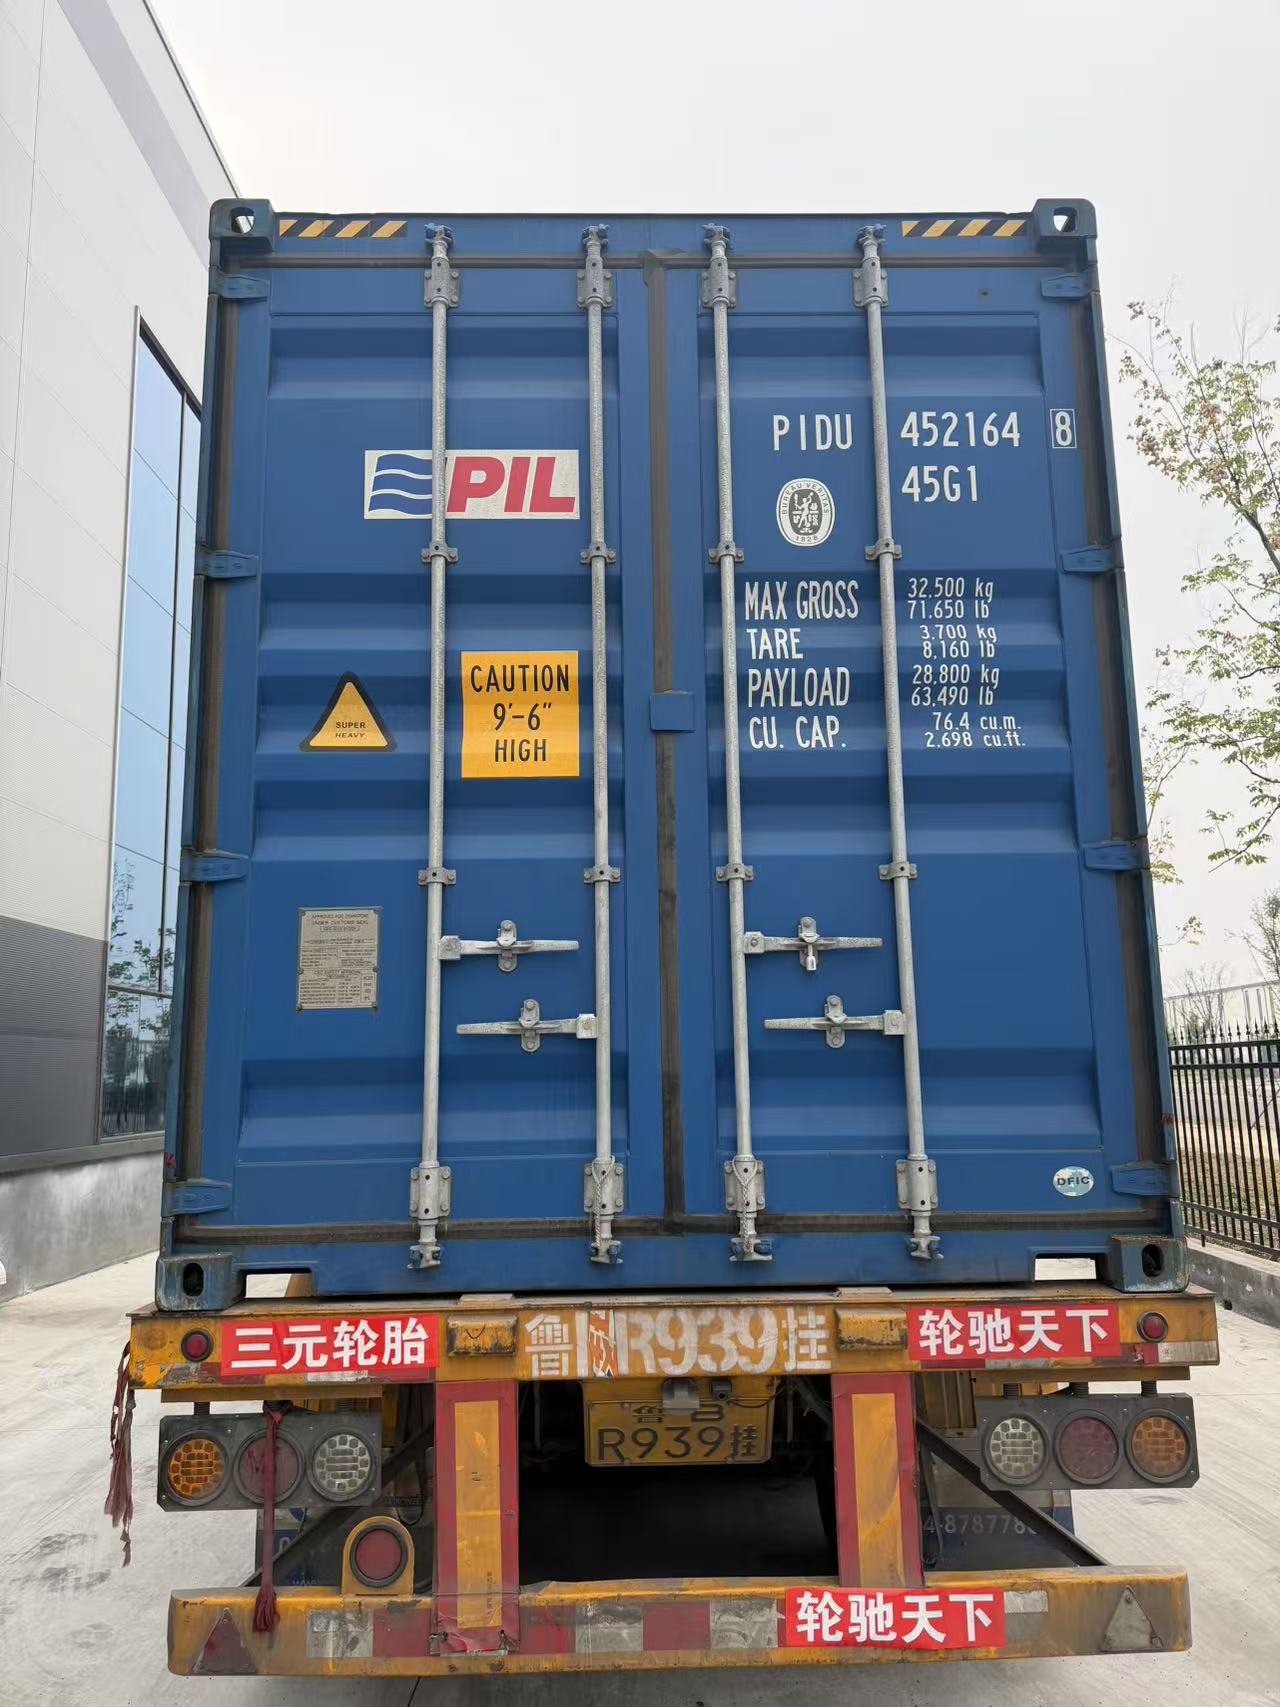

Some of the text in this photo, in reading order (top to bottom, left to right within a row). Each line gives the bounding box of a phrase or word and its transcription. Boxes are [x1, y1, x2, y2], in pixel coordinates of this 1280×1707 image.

[773, 411, 1073, 451] PIDU 452164 8
[446, 456, 576, 513] PIL
[902, 465, 979, 502] 45G1
[745, 580, 859, 621] MAX GROSS
[974, 577, 994, 603] kg
[974, 599, 990, 619] lb
[746, 627, 804, 660] TARE
[976, 624, 997, 643] kg
[979, 640, 996, 658] lb
[470, 664, 570, 693] CAUTION
[748, 667, 850, 708] PAYLOAD
[980, 664, 1000, 690] kg
[979, 686, 994, 705] lb
[335, 721, 367, 729] SUPER
[749, 715, 847, 749] CU. CAP.
[932, 711, 970, 731] 76.4
[494, 738, 548, 763] HIGH
[1056, 1176, 1091, 1186] DFIC
[230, 1317, 430, 1371] 三元轮胎
[918, 1308, 1110, 1357] 轮驰天下
[598, 1423, 758, 1463] R939挂
[796, 1590, 995, 1644] 轮驰天下
